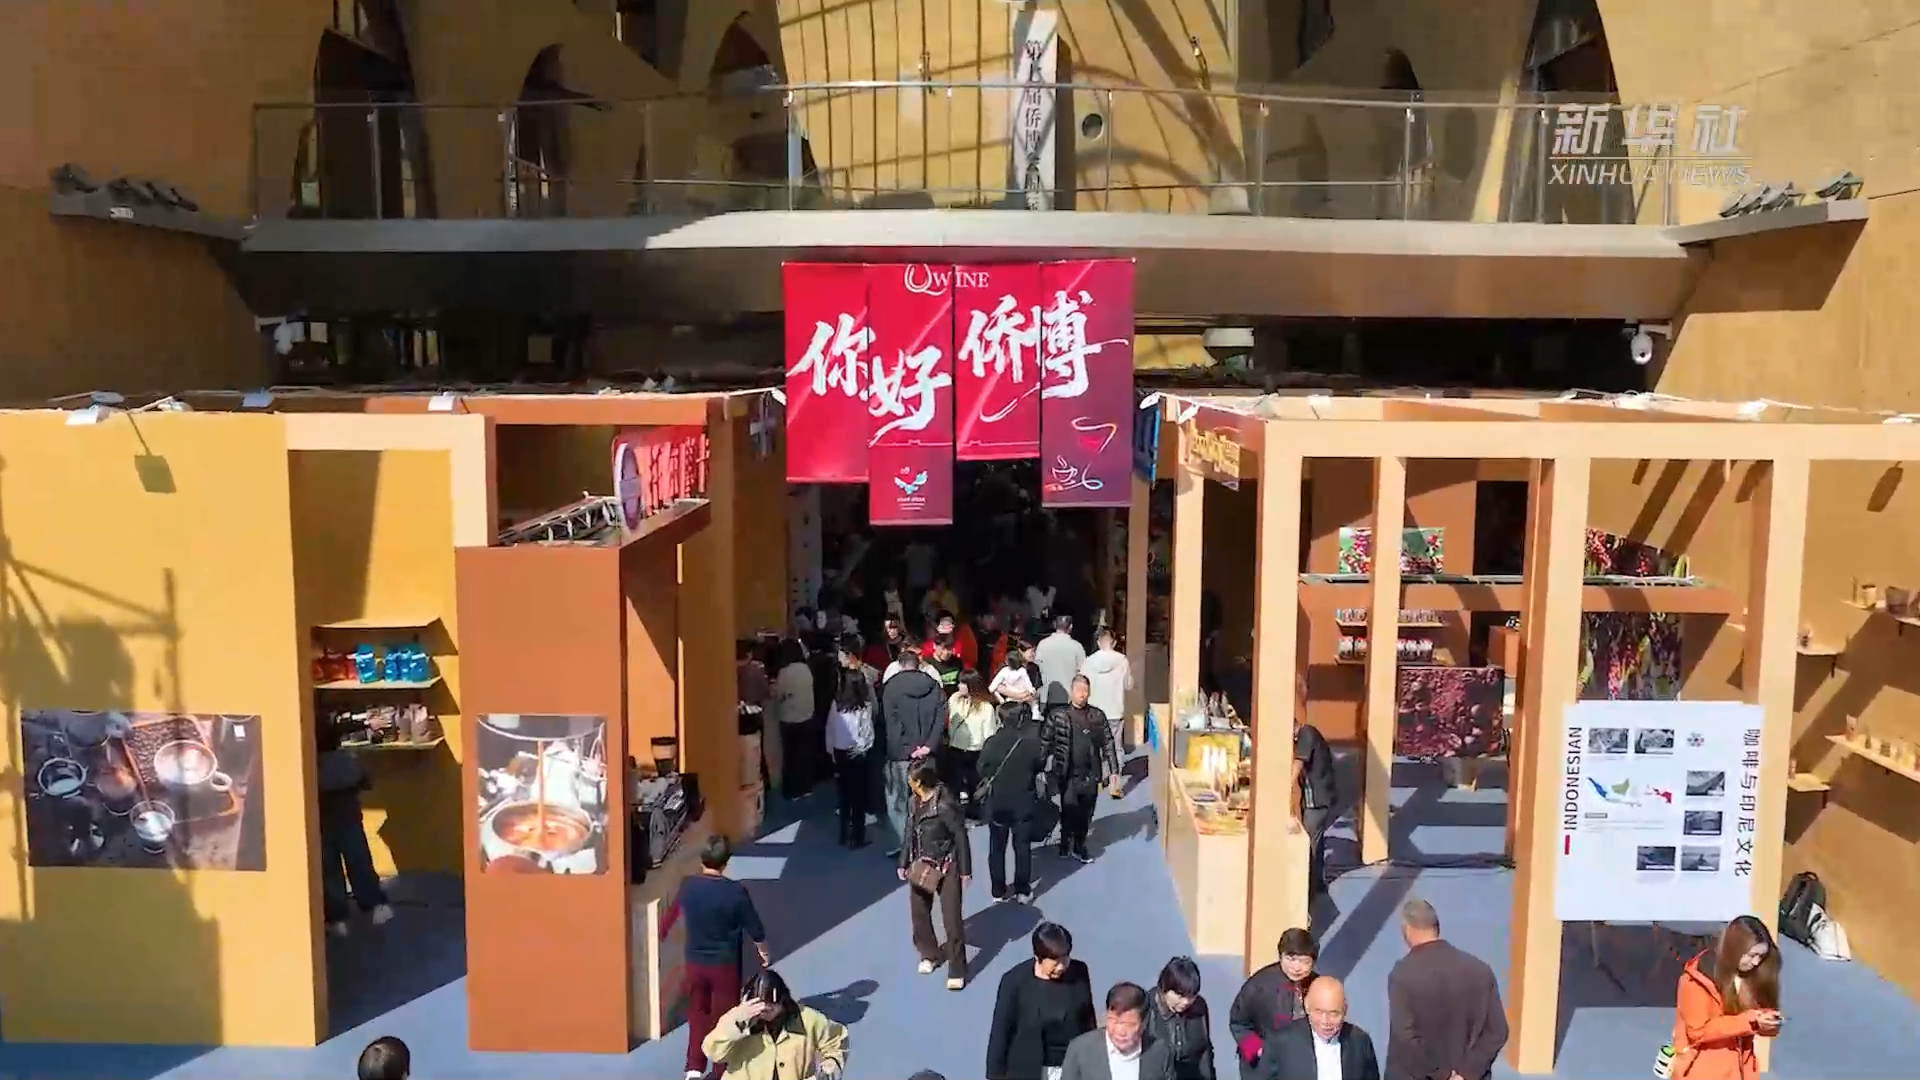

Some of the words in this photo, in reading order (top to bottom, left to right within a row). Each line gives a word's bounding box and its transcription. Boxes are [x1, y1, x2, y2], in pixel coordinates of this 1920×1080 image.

[1564, 727, 1582, 830] INDONESIAN
[1734, 728, 1761, 877] 咖啡与印尼文化
